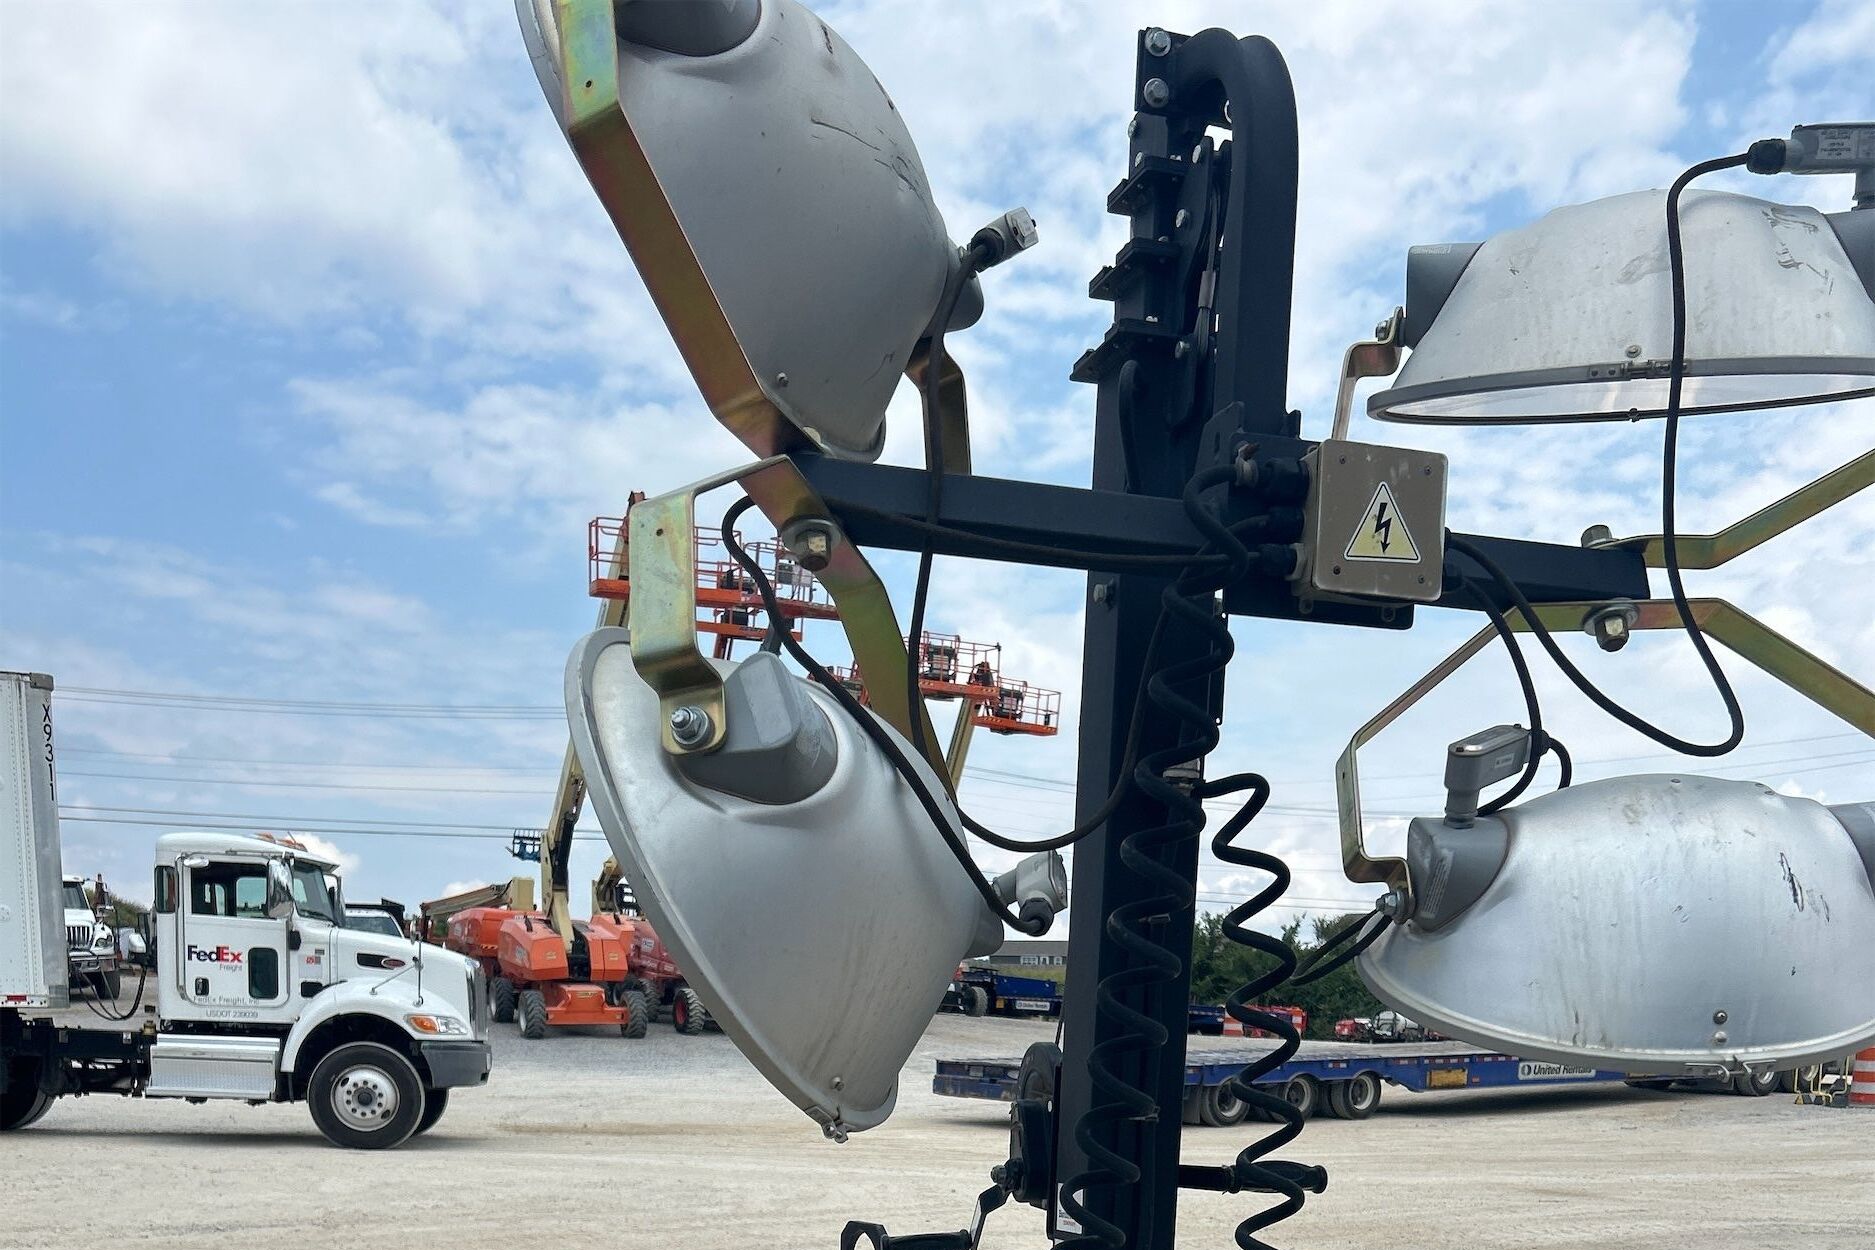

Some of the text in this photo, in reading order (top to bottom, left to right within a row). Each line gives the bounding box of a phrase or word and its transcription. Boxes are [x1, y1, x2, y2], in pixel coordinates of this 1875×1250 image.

[187, 944, 243, 964] FedEx
[219, 964, 243, 972] Freight
[1533, 1064, 1561, 1076] United
